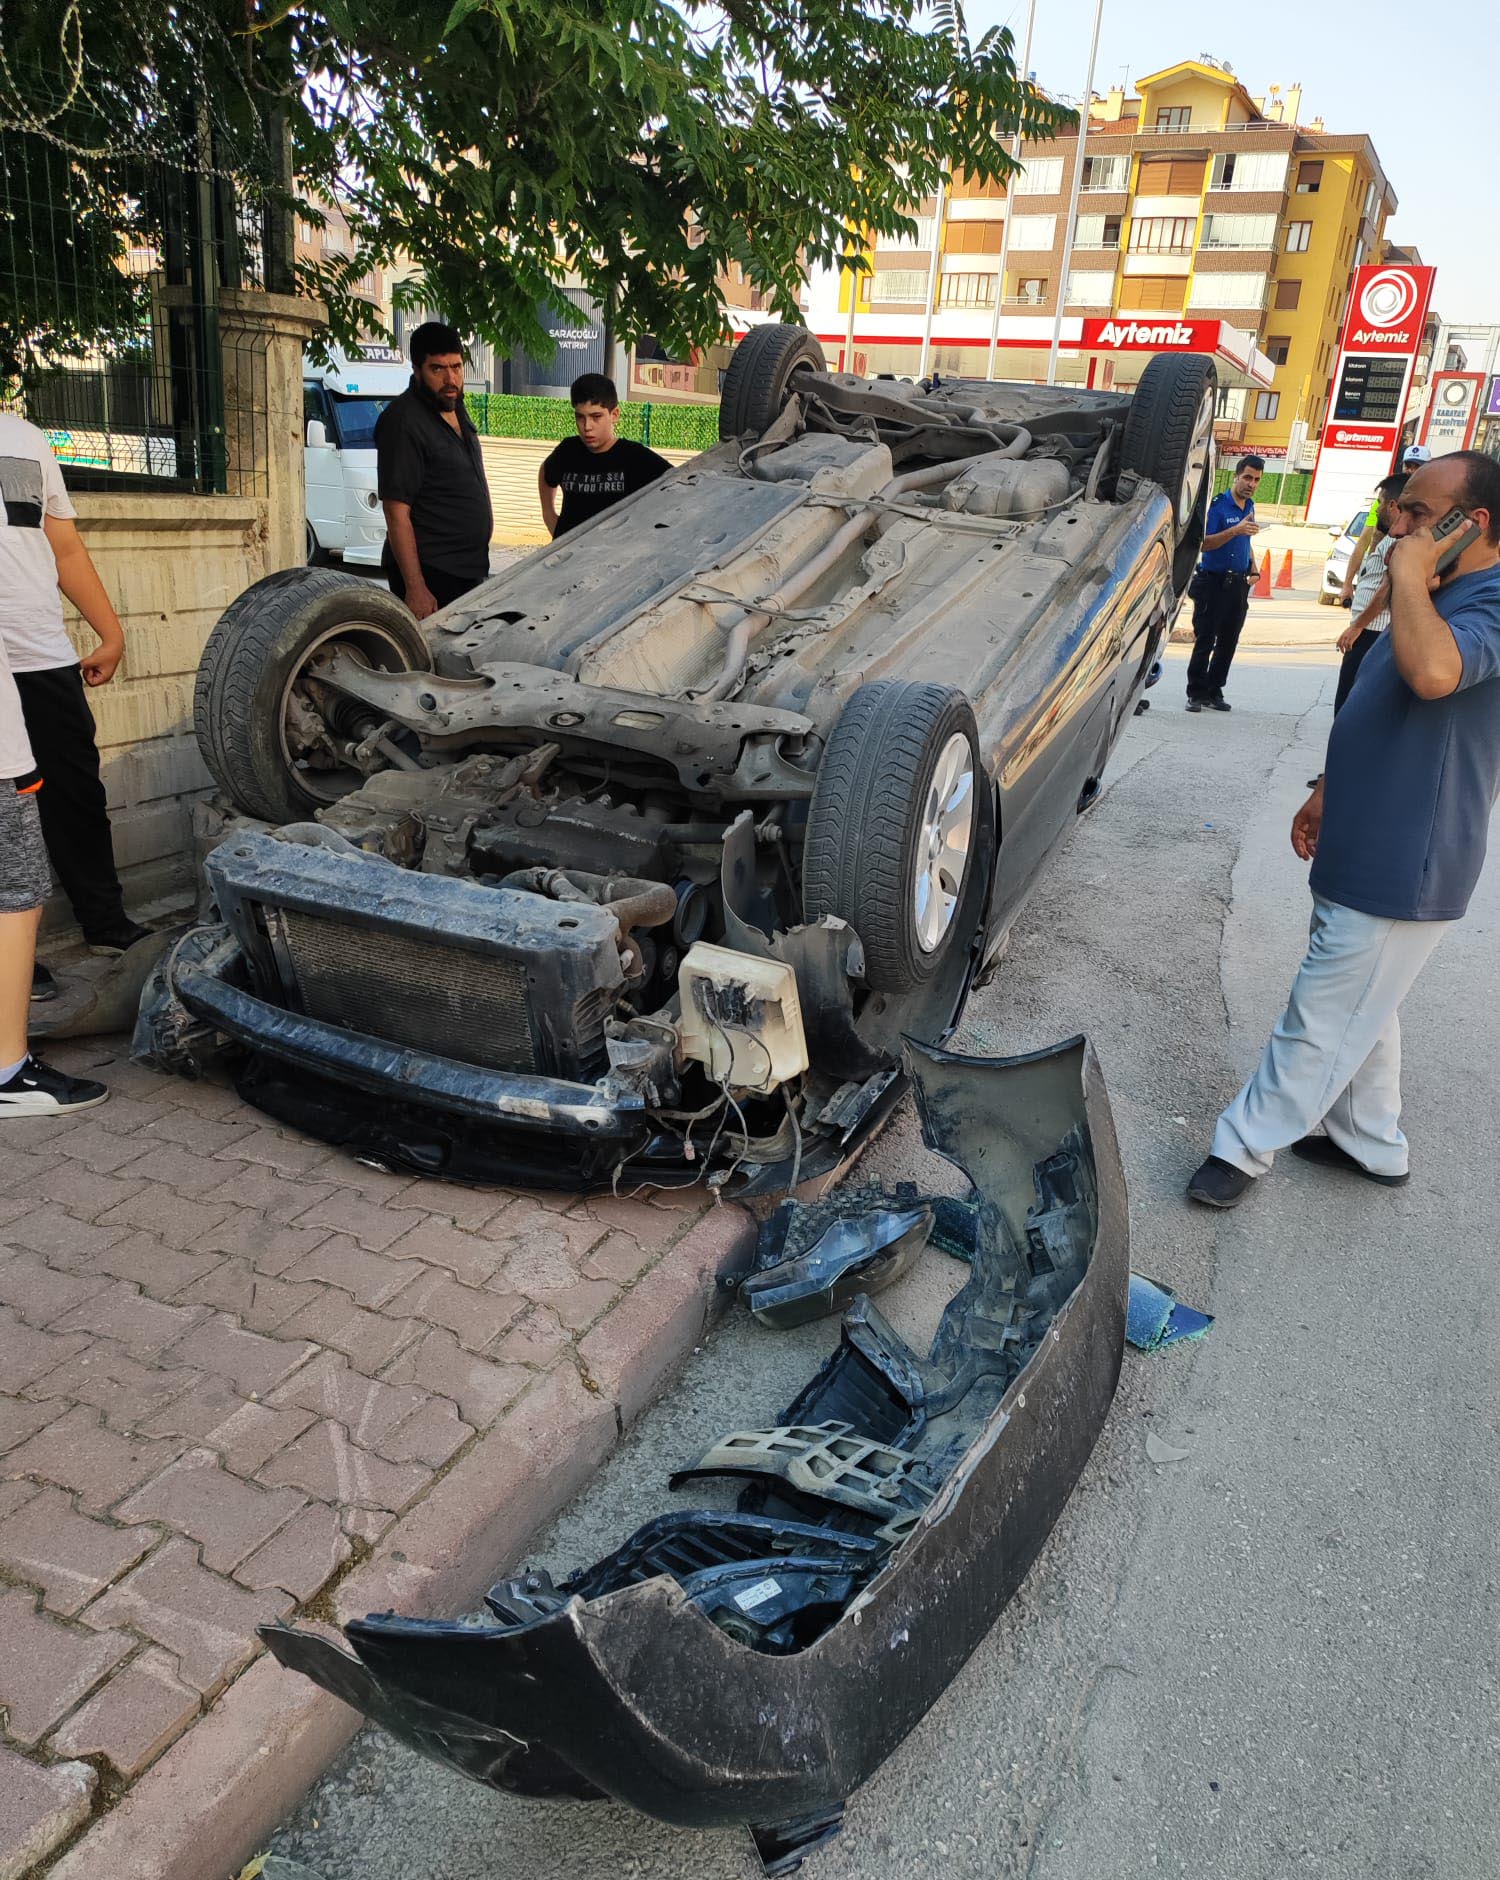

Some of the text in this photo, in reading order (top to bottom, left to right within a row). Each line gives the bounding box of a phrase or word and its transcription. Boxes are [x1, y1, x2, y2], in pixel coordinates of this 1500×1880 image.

[549, 329, 598, 340] SARAÇOĞLU
[1097, 321, 1193, 347] Aytemiz
[1352, 330, 1409, 344] Aytemiz
[584, 474, 601, 482] THE
[578, 482, 596, 493] YOU
